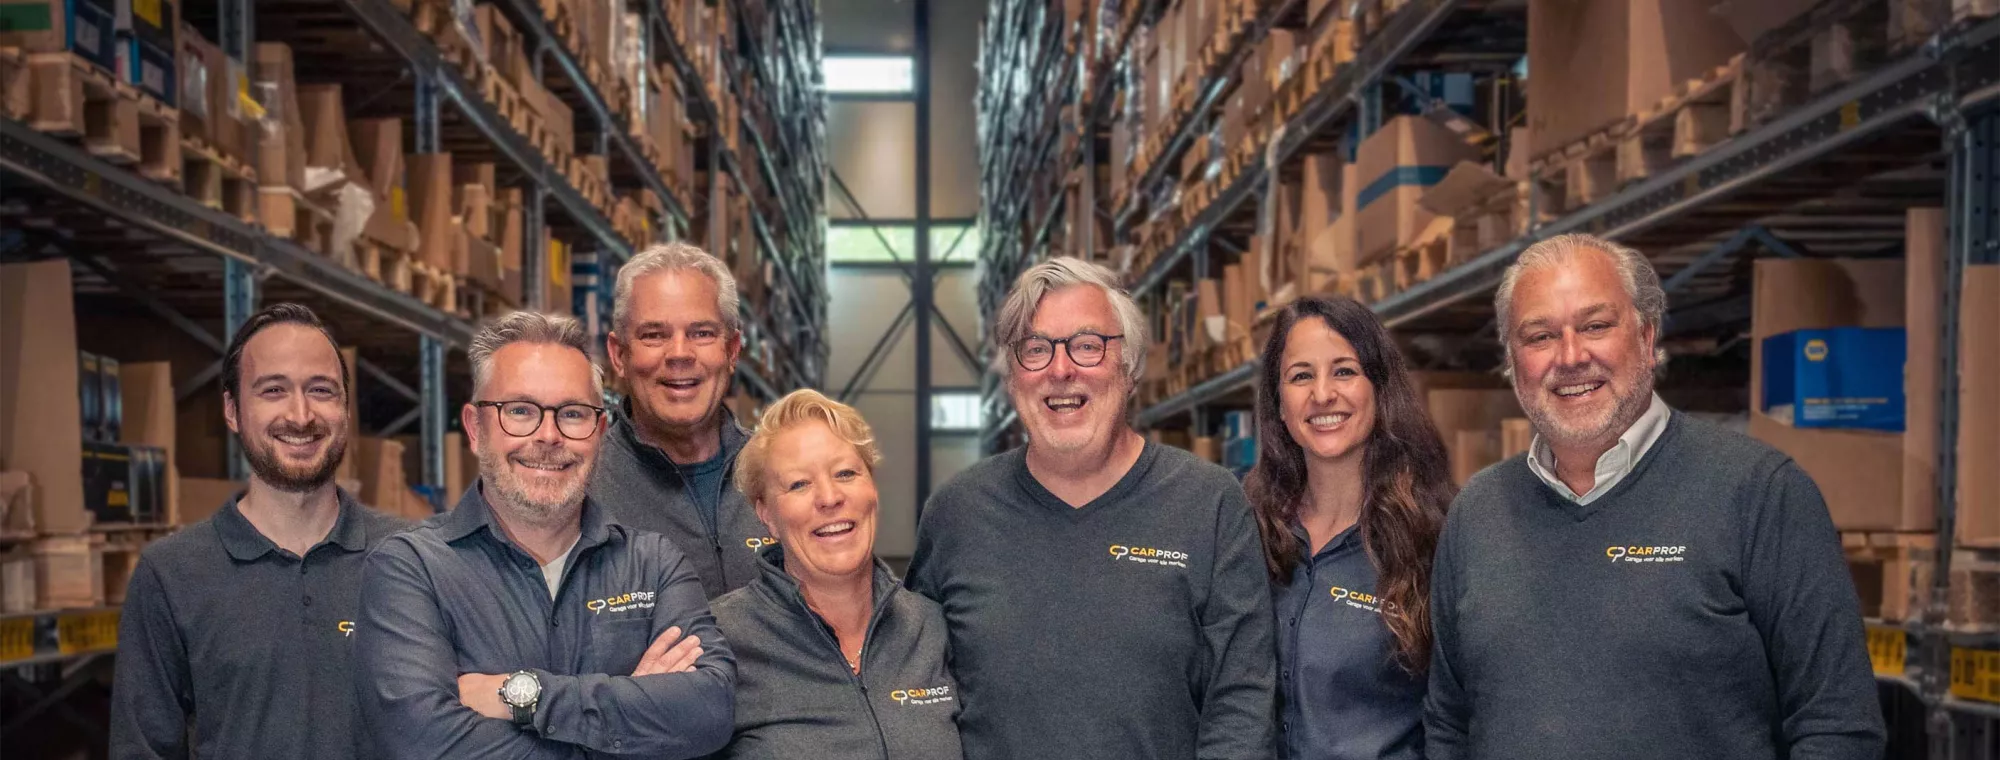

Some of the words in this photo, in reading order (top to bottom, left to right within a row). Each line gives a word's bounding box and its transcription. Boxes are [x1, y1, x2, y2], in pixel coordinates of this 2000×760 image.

[1130, 547, 1189, 560] CARPROF
[1627, 546, 1687, 555] CARPROF
[607, 591, 655, 605] CARPROF
[908, 685, 950, 697] CARPROF
